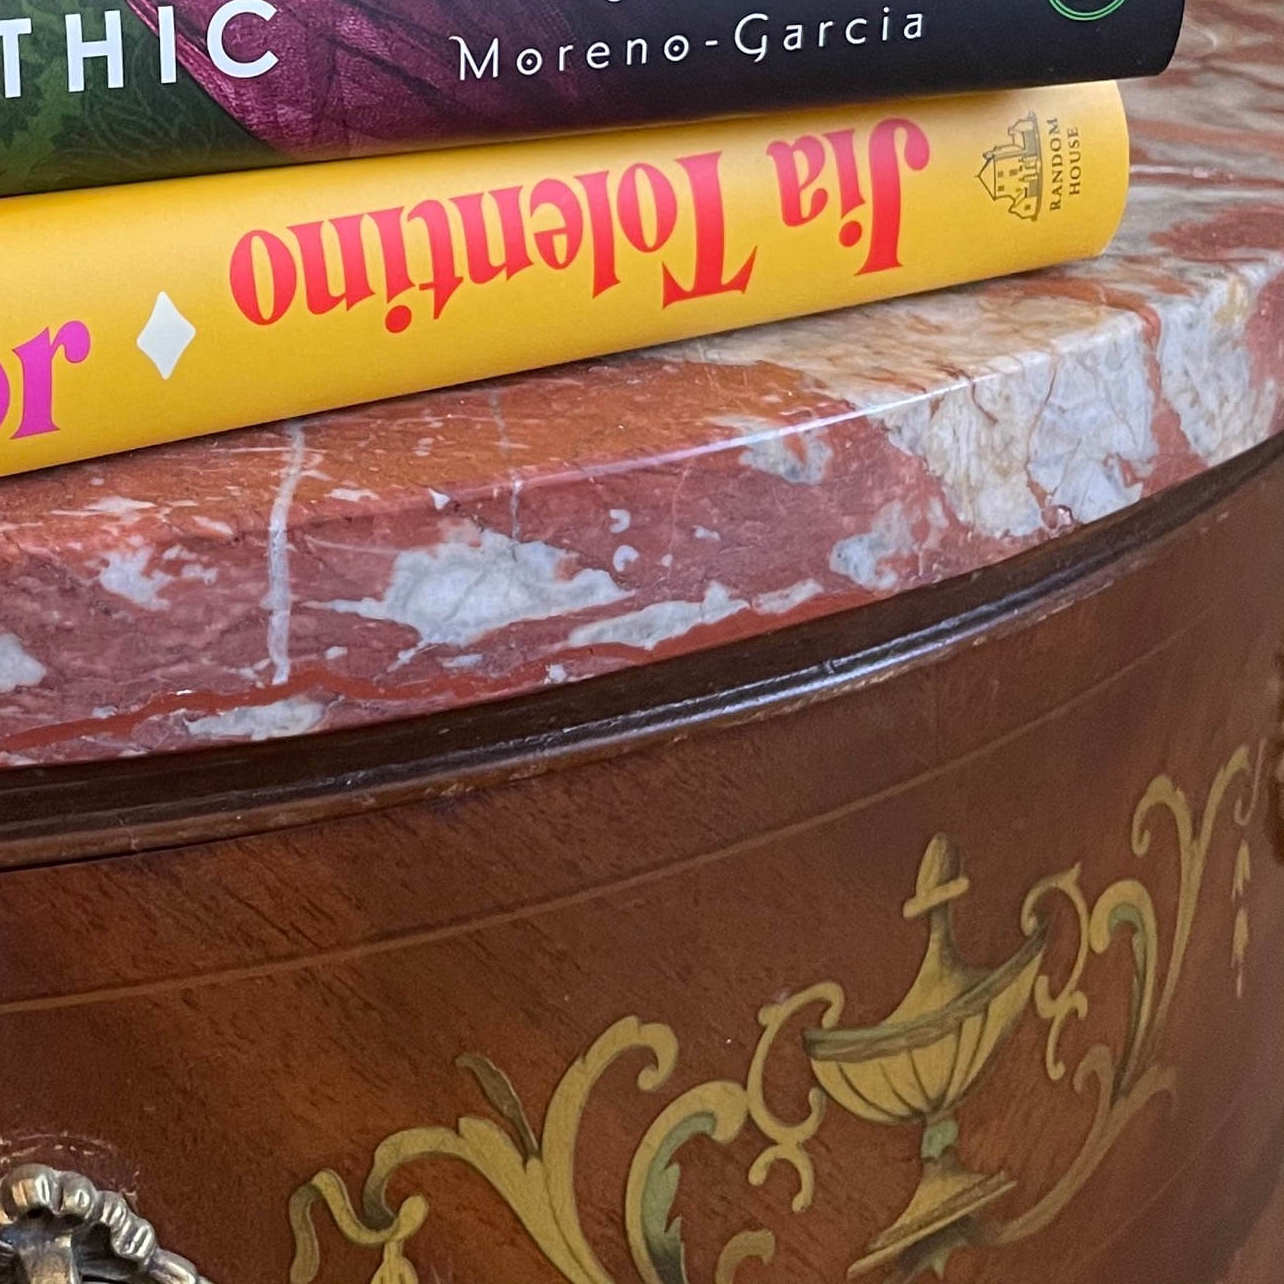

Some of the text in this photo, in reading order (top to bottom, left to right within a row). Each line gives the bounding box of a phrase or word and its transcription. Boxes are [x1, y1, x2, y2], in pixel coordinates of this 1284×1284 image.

[448, 6, 924, 81] Moreno-Garcia
[1048, 118, 1063, 211] RANDOM
[1067, 127, 1081, 196] HOUSE
[228, 117, 930, 334] Jia Tolentino
